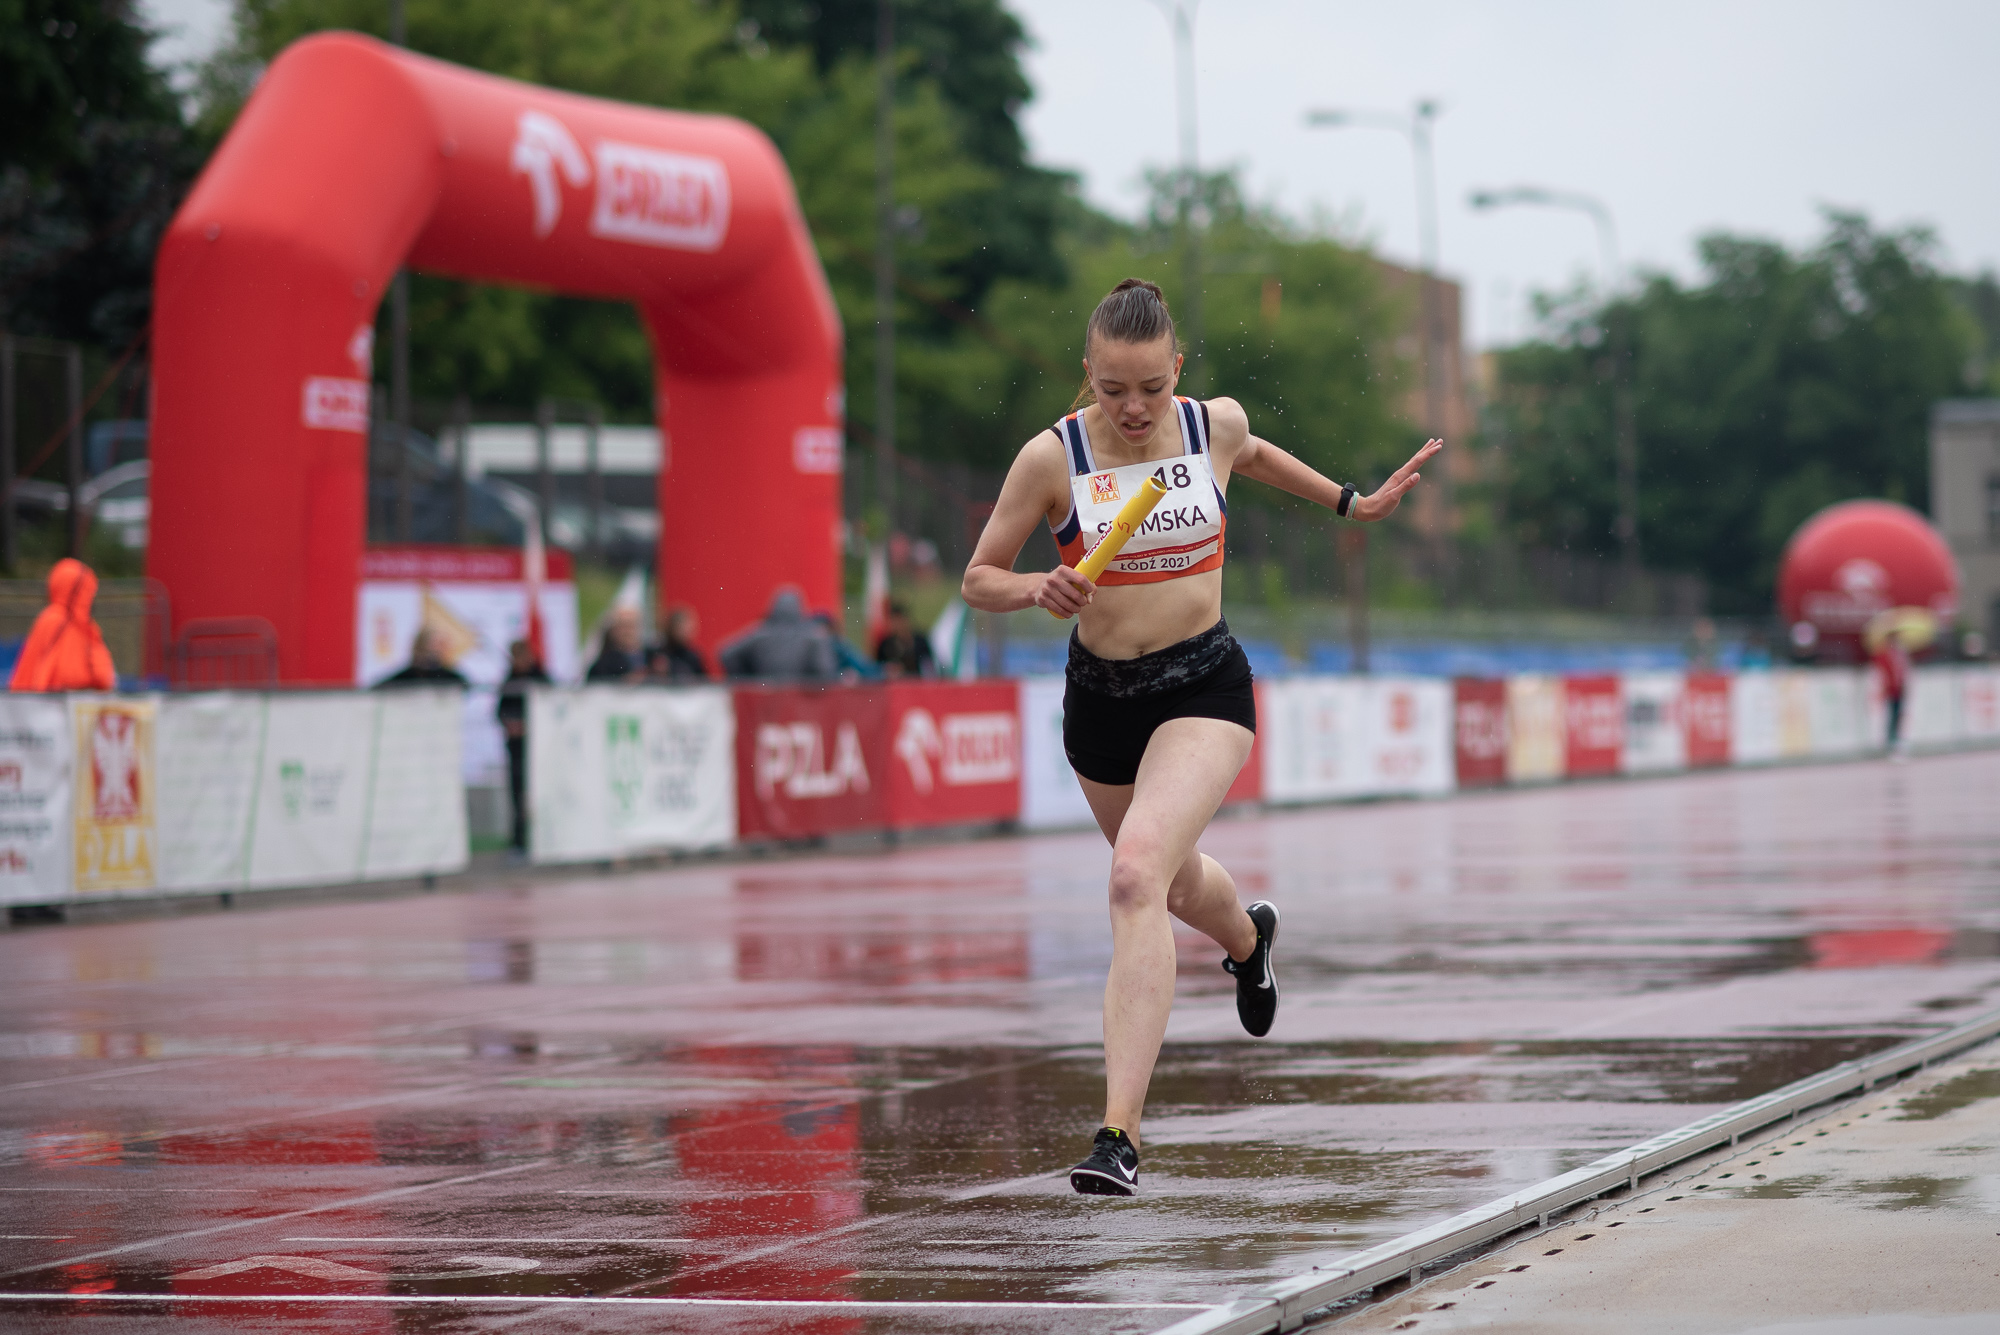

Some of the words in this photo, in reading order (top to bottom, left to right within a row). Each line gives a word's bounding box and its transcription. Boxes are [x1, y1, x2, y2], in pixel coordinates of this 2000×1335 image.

[1153, 463, 1192, 491] 18
[1093, 491, 1119, 503] PZLA
[1097, 505, 1208, 537] SMSKA
[1120, 556, 1157, 571] ŁÓDŹ
[1160, 555, 1190, 569] 2021
[755, 721, 872, 800] PZLA
